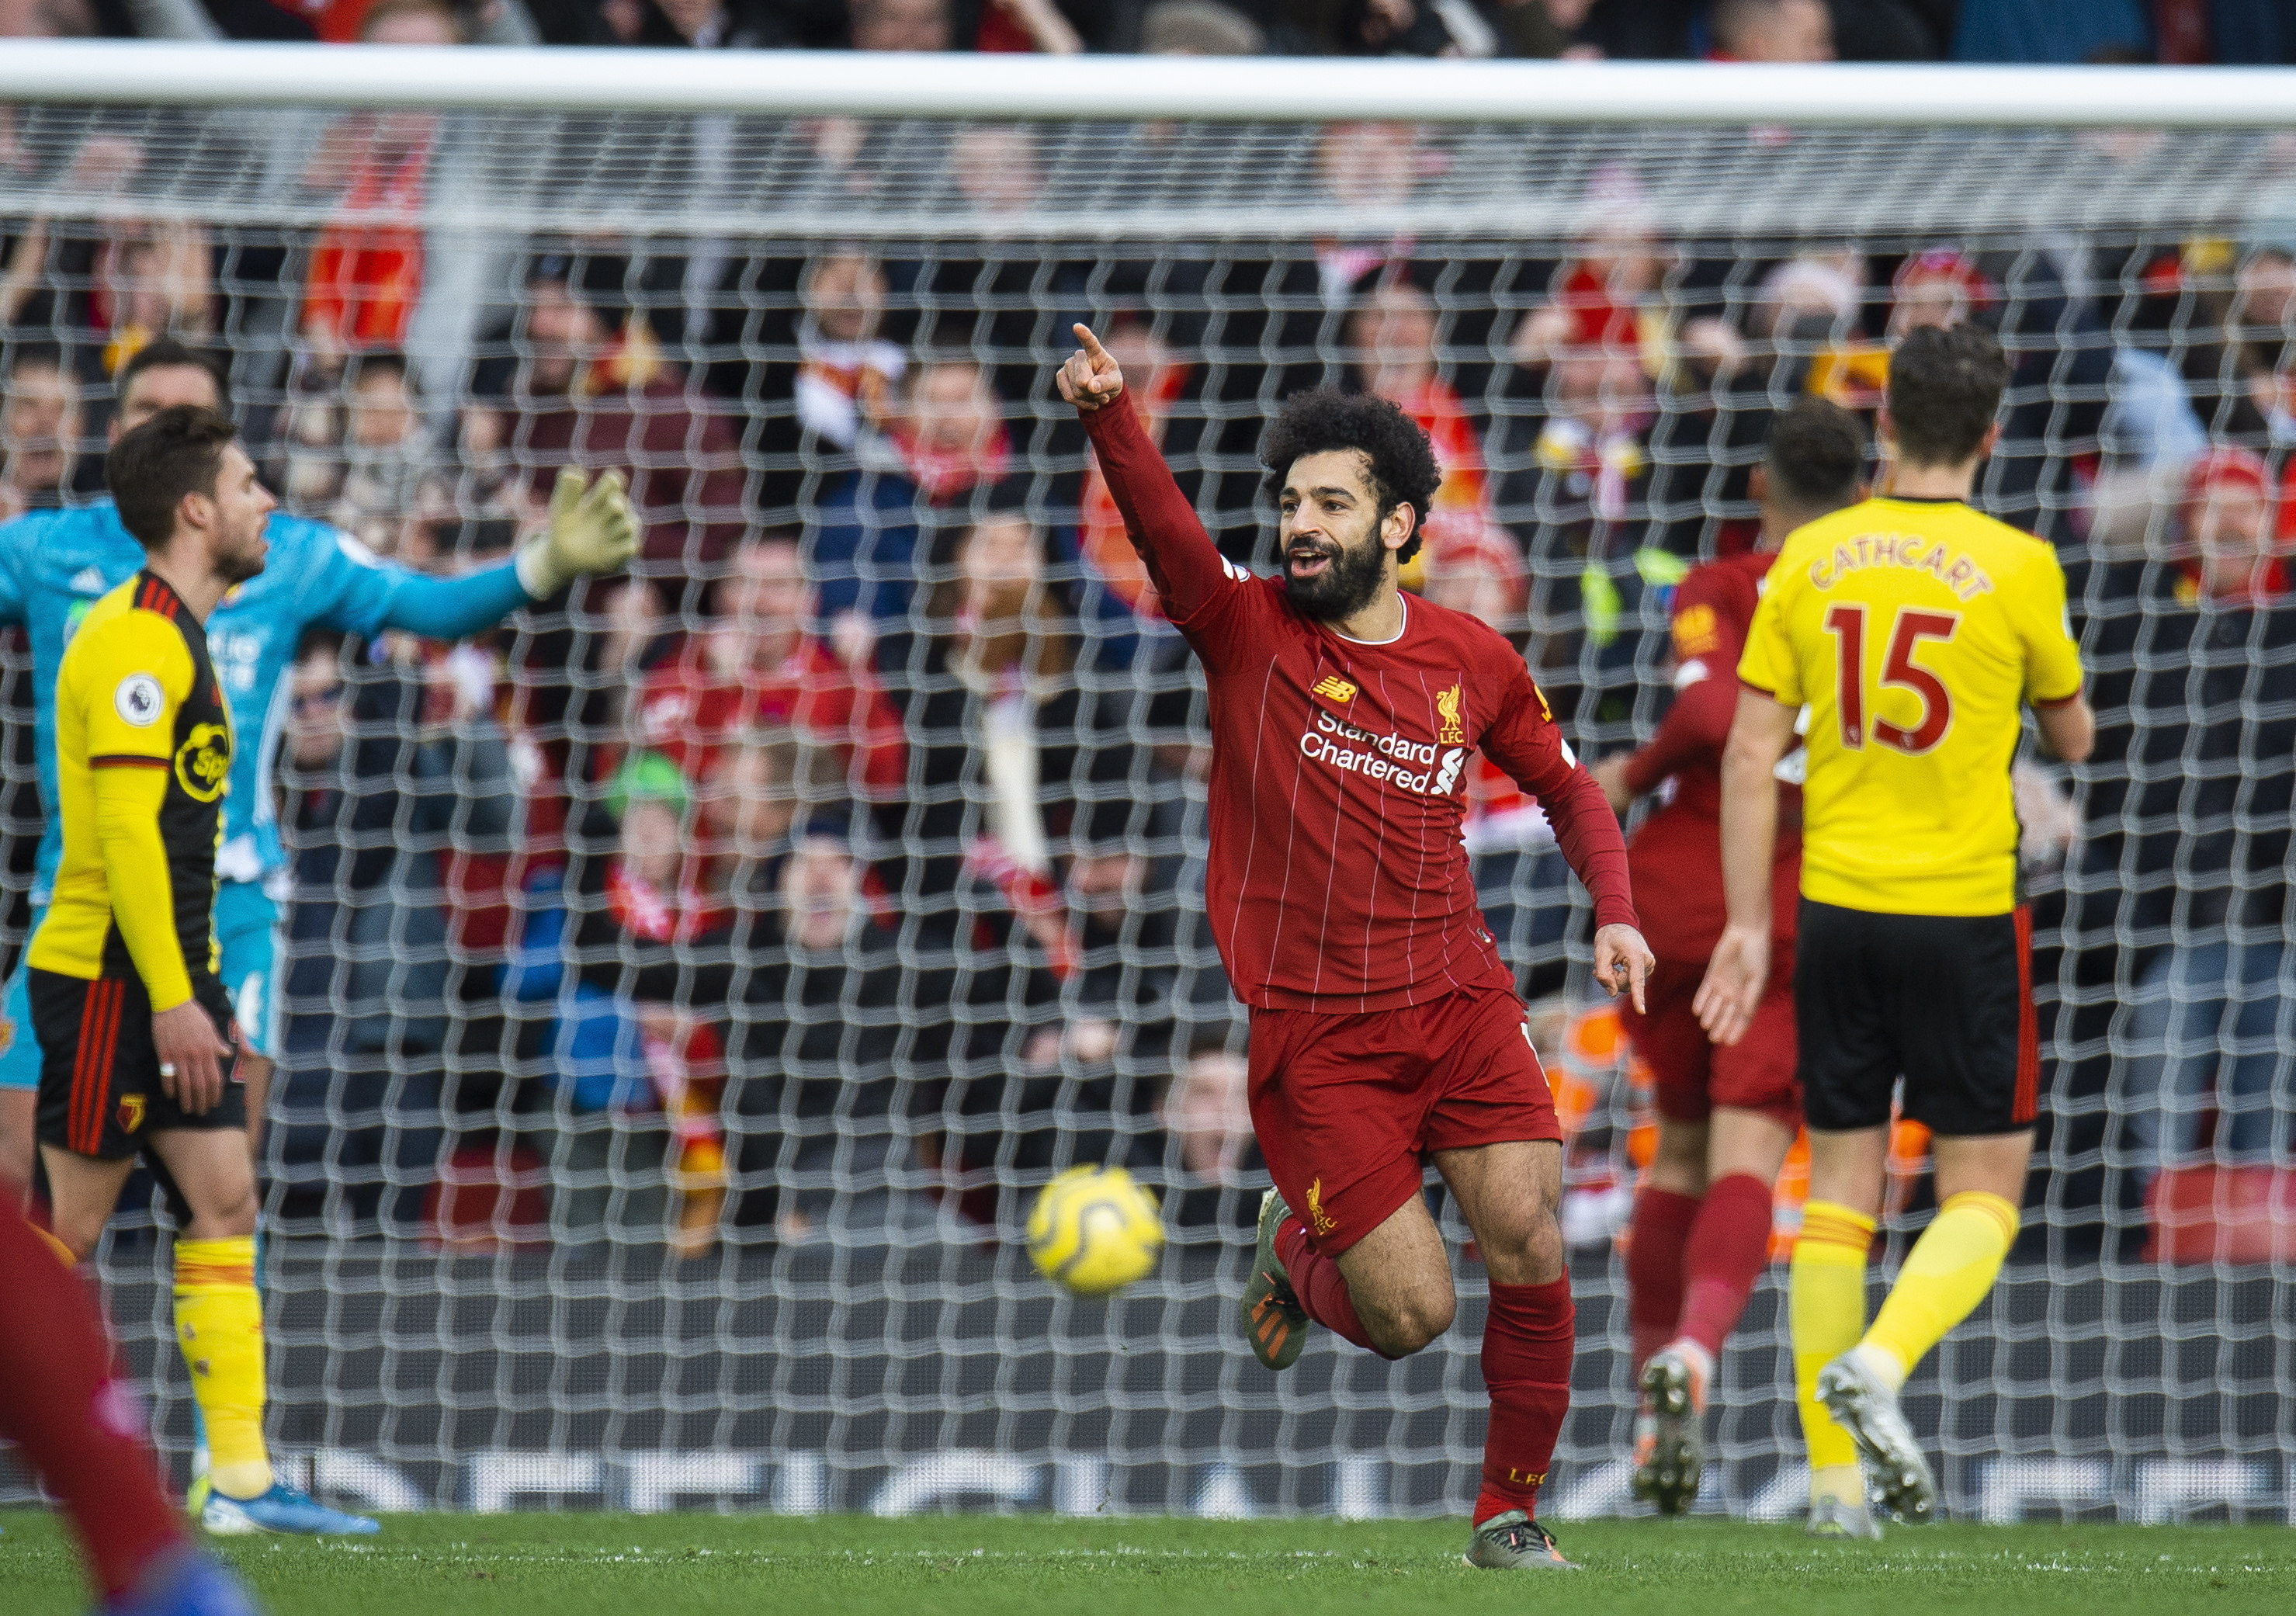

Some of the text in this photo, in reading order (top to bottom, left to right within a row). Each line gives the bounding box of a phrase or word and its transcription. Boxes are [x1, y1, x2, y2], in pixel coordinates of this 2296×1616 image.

[1809, 535, 1995, 603] CATHCART
[1822, 600, 1964, 758] 15
[1300, 732, 1431, 793] Chartered
[1317, 709, 1438, 765] Standard
